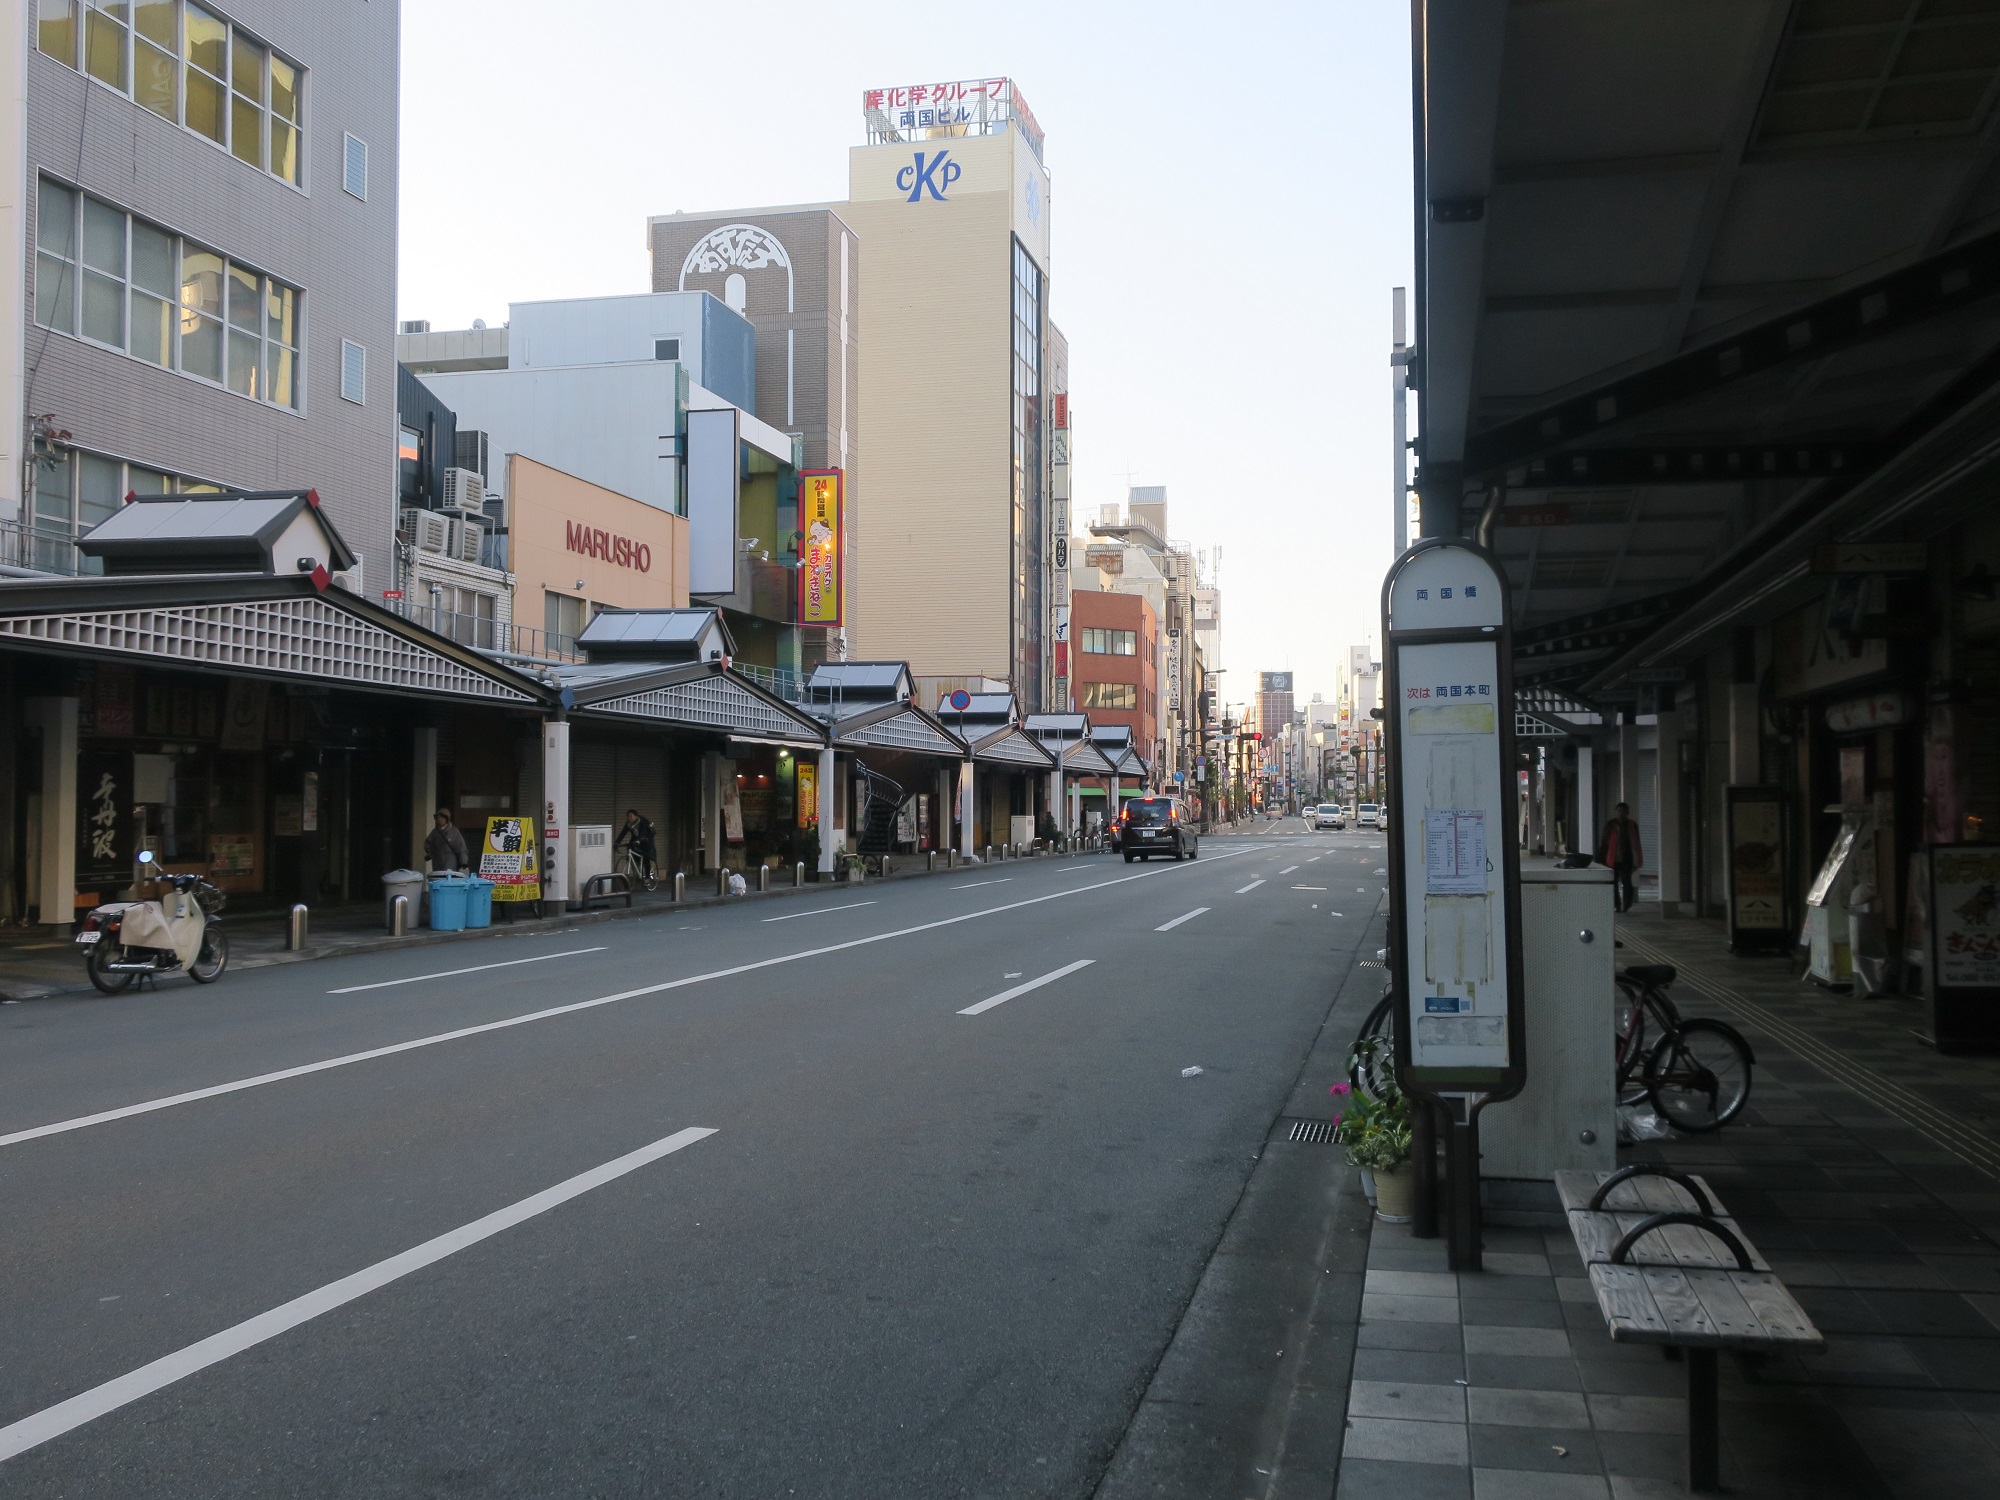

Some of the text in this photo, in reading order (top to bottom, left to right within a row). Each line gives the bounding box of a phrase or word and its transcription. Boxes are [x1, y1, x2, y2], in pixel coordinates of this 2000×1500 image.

[900, 107, 971, 128] 両国ビル
[566, 519, 652, 574] MARUSHO
[1057, 541, 1065, 566] リバティ
[809, 546, 823, 617] まねきねこ
[823, 553, 833, 587] カラオケ
[1416, 585, 1477, 601] 両国橋
[1407, 684, 1490, 699] 次は 両国本町
[490, 819, 523, 853] 半額
